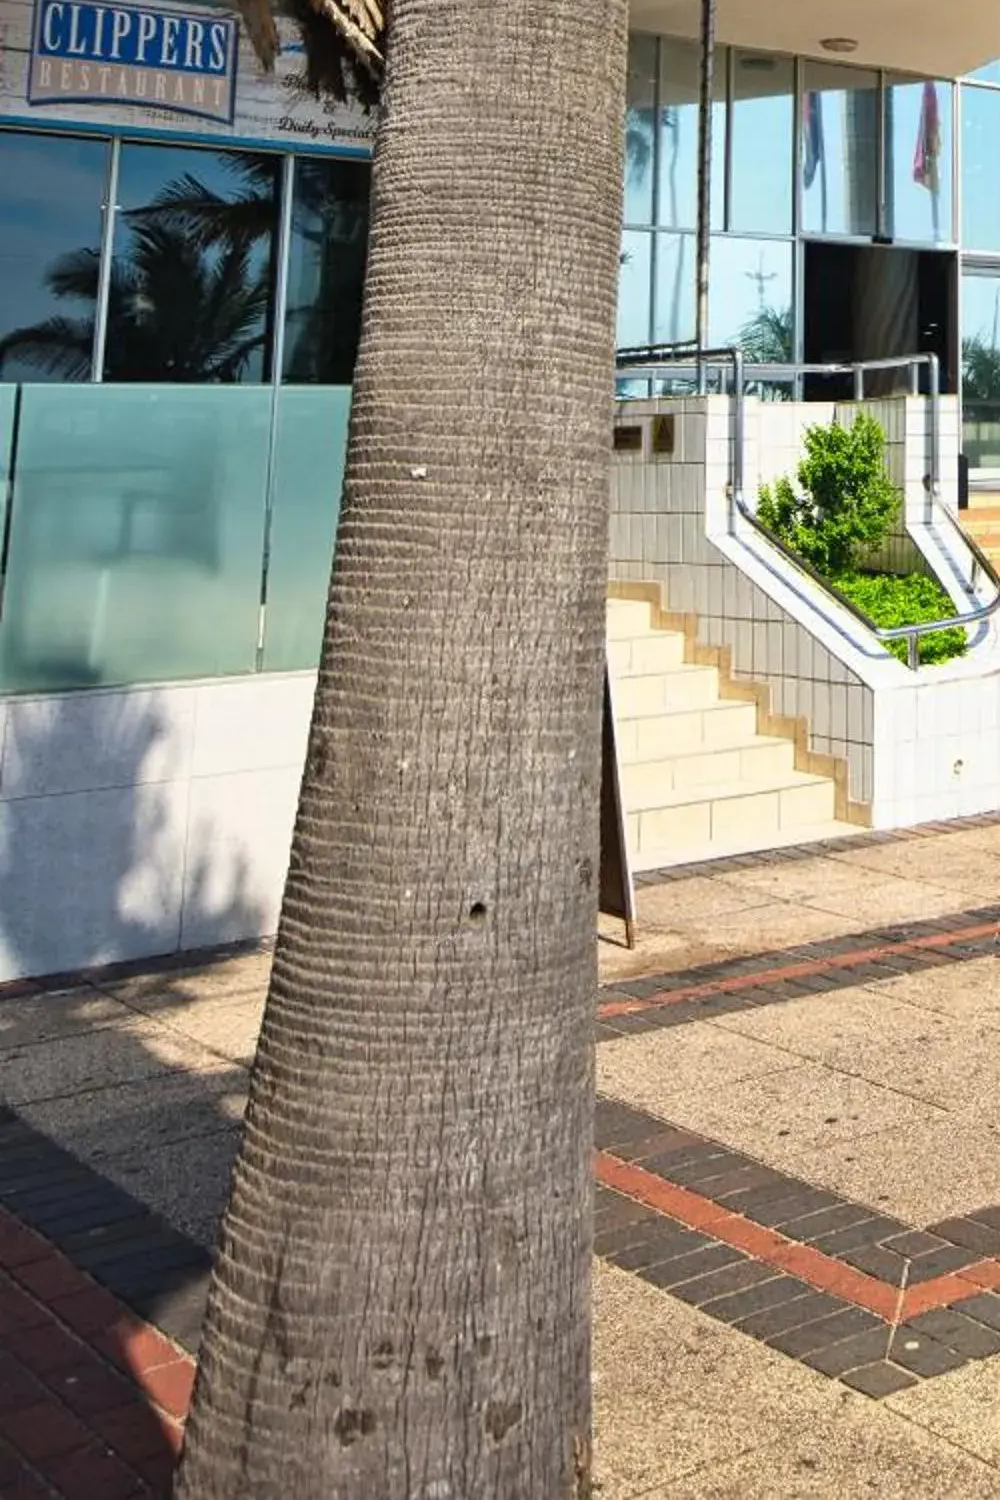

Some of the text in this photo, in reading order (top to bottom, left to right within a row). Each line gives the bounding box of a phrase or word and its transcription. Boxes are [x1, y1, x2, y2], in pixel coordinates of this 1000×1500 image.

[43, 2, 226, 70] CLIPPERS
[38, 59, 227, 107] RESTAURANT
[277, 116, 320, 139] Daily
